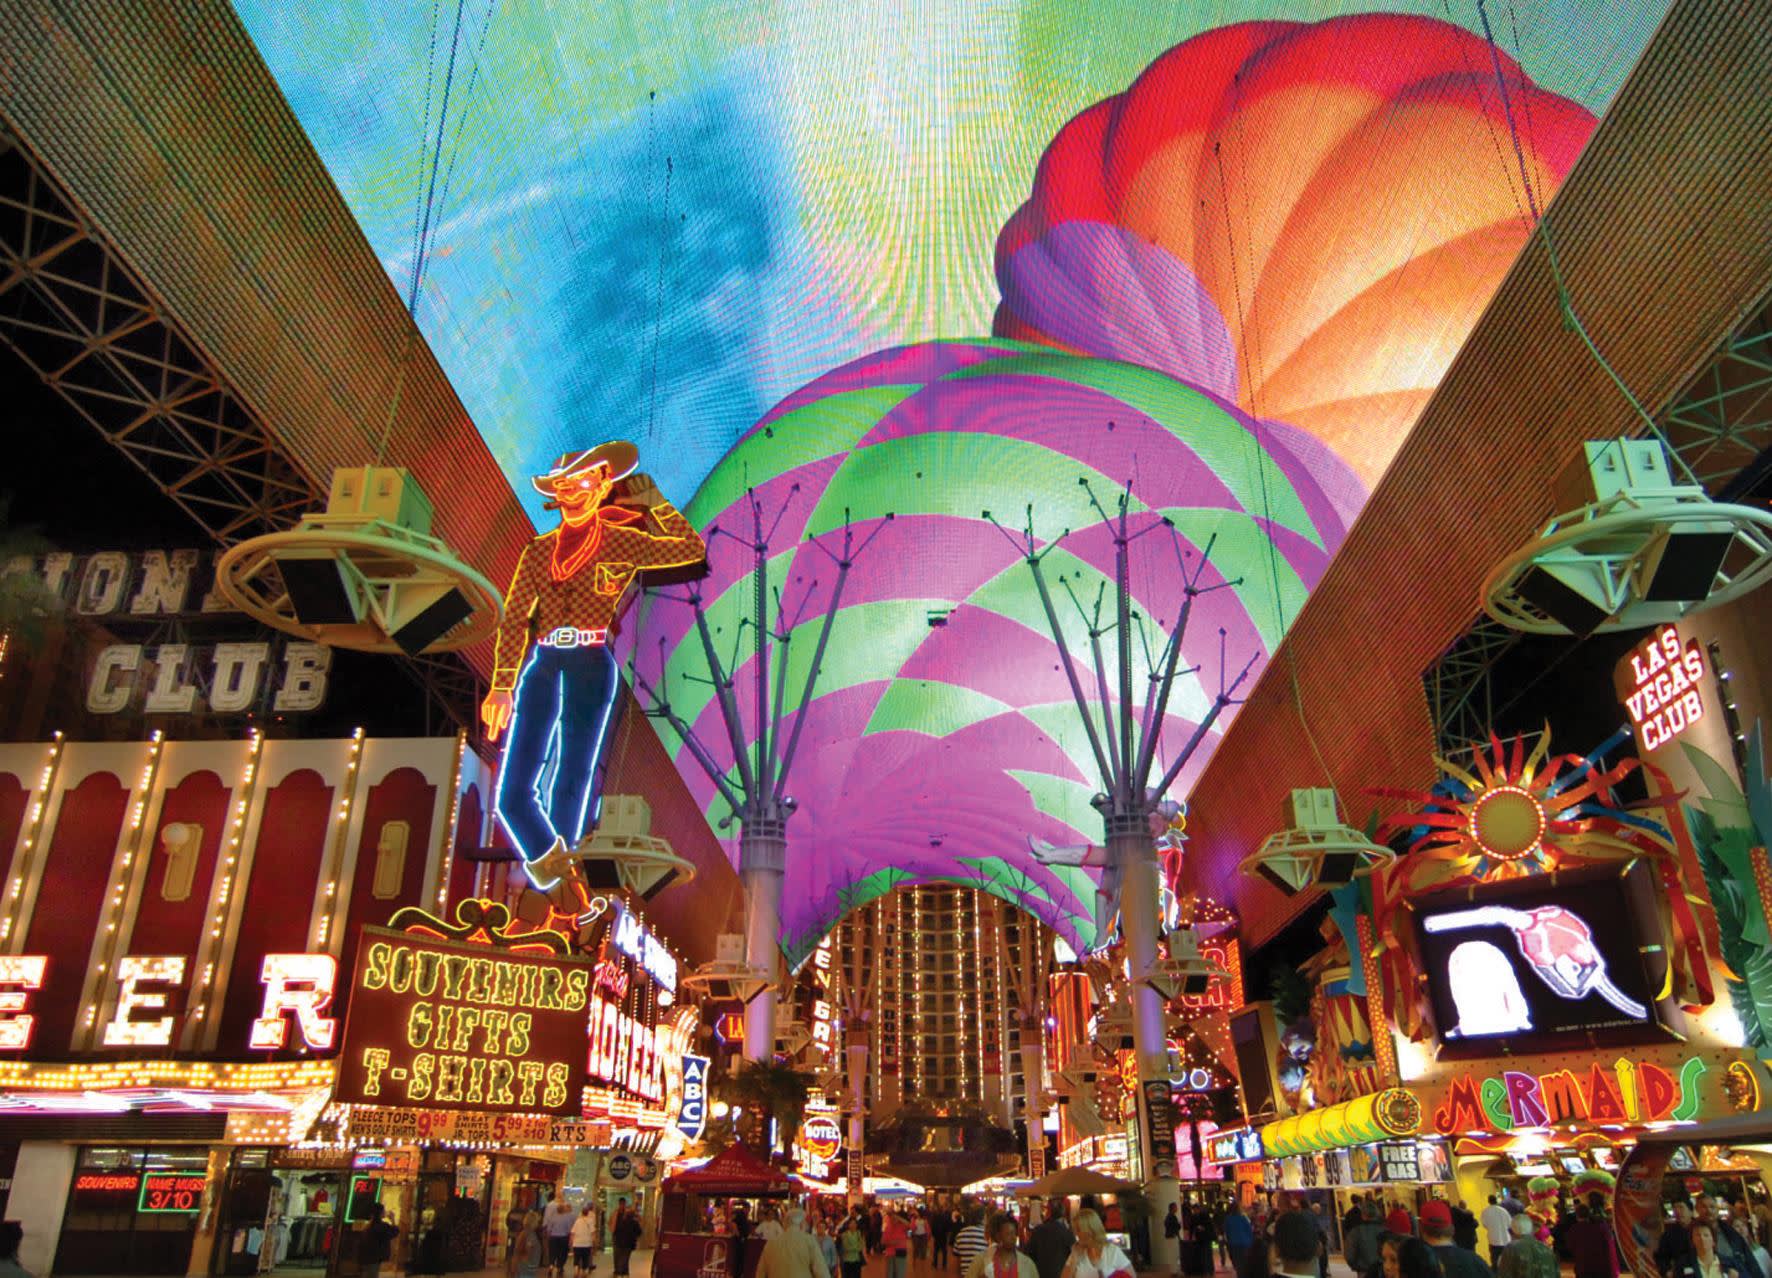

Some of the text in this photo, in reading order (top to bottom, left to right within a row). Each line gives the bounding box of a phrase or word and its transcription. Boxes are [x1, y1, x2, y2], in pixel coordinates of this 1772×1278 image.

[85, 642, 333, 713] CLUB
[1631, 628, 1680, 685] LAS
[1626, 649, 1703, 722] VEGAS
[1641, 690, 1702, 750] CLUB
[364, 943, 588, 1011] SOUVENIRS
[408, 1002, 532, 1056] GIFTS
[363, 1048, 569, 1108] T-SHIRTS
[682, 1062, 702, 1120] ABC
[353, 1110, 416, 1124] FLEECE TOPS
[468, 1130, 490, 1140] TOPS
[523, 1129, 546, 1140] $10
[1382, 1146, 1417, 1162] FREE
[1387, 1163, 1417, 1180] GAS
[77, 1176, 138, 1190] SOUVENIRS
[149, 1191, 193, 1209] 3/10
